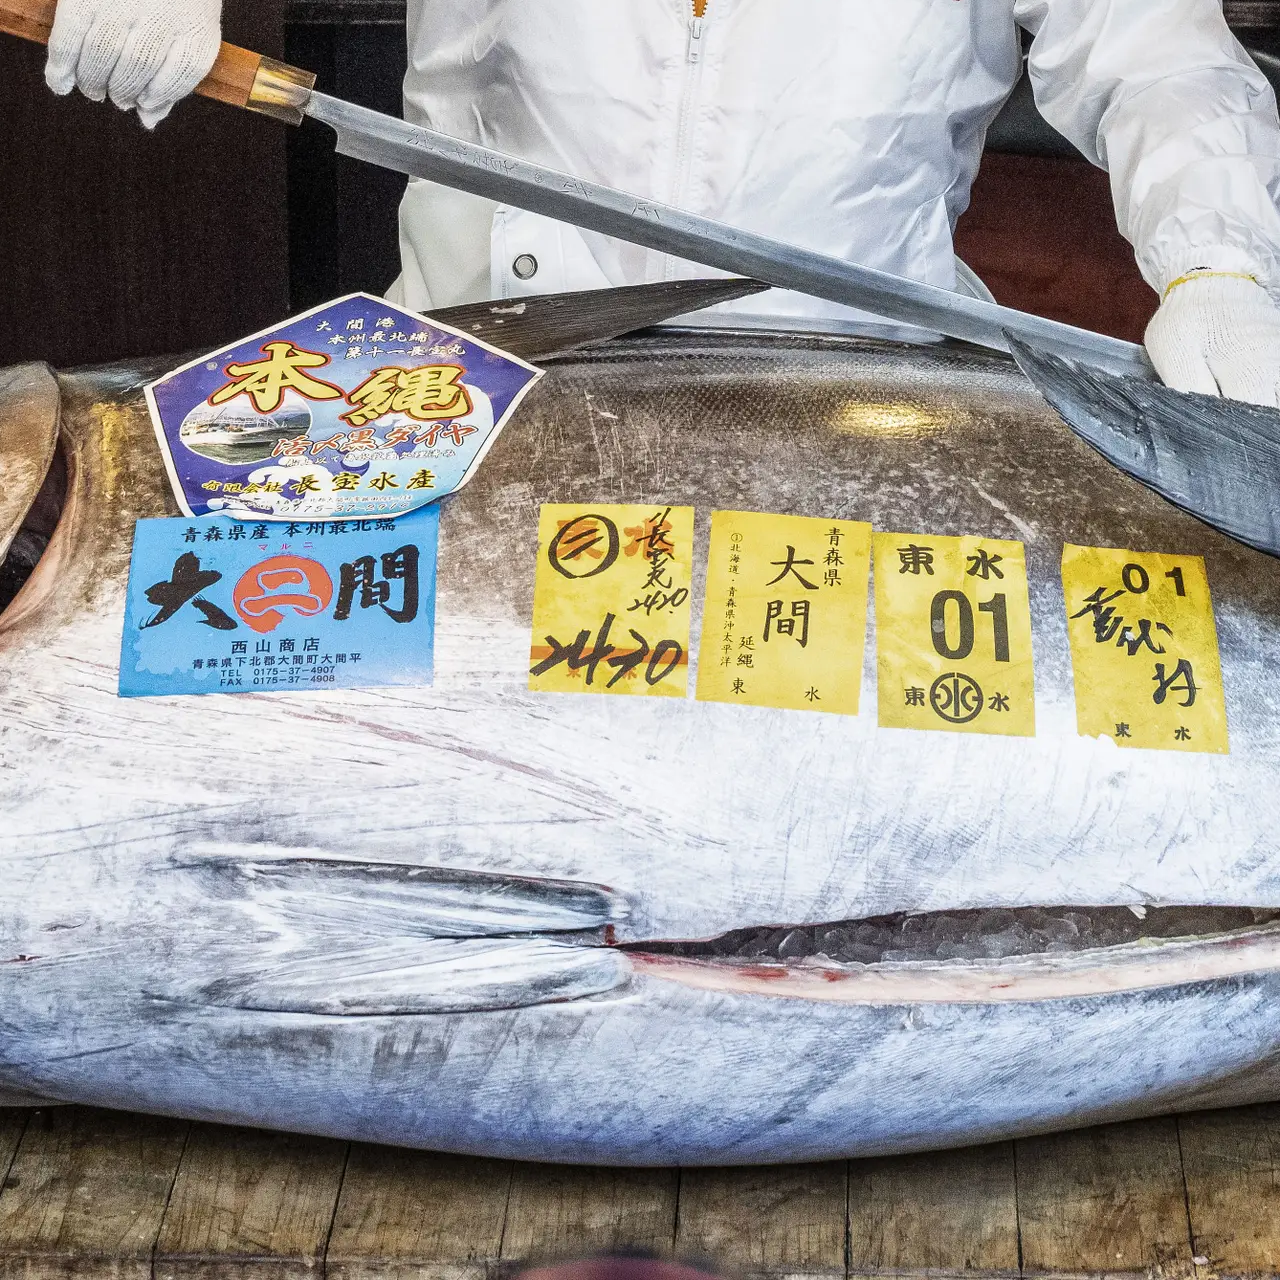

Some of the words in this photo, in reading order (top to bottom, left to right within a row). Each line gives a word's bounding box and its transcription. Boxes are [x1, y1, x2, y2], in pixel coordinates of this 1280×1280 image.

[316, 317, 395, 332] 大間港
[201, 480, 283, 494] 有限会社
[290, 470, 437, 492] 長宝水産
[181, 523, 270, 542] 青森県産
[282, 519, 396, 538] 本州最北端
[823, 527, 845, 586] 青森県
[763, 545, 819, 648] 大間
[930, 589, 1010, 662] 01
[231, 637, 320, 654] 西山商店
[736, 635, 756, 668] 延縄
[220, 669, 242, 678] TEL
[253, 666, 336, 676] 0175-37-4907
[220, 677, 243, 687] FAX
[253, 674, 336, 685] 0175-37-4908
